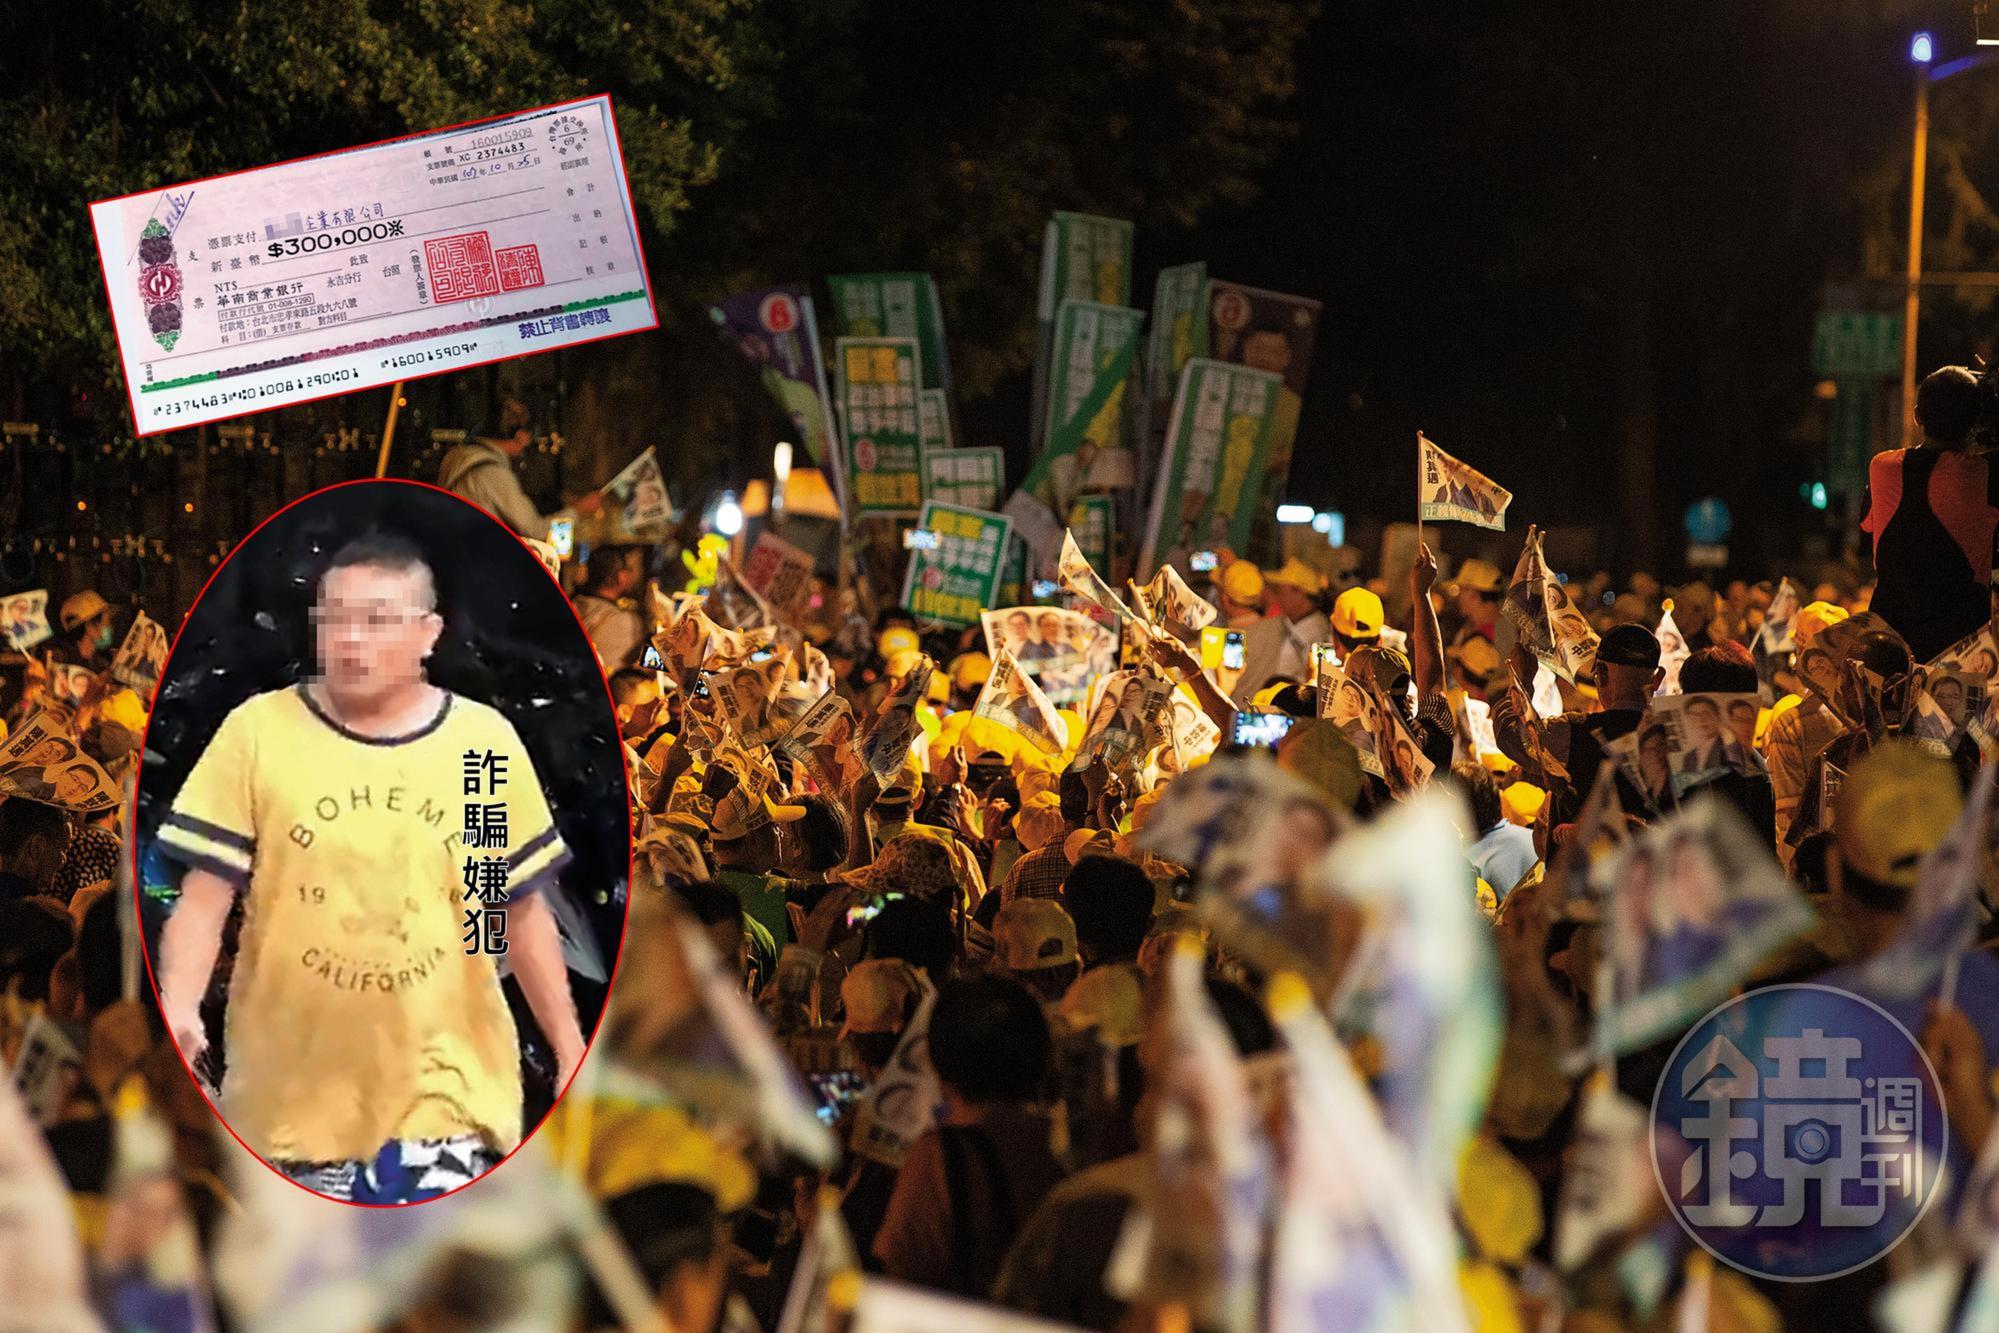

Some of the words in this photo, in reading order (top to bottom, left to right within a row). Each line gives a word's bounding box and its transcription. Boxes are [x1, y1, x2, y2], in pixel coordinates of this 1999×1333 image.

[459, 152, 471, 162] XC
[477, 143, 525, 160] 2374483
[217, 282, 304, 308] 華南商業銀行
[8, 724, 46, 758] 陳其邁
[289, 784, 463, 858] BOHEME
[301, 946, 446, 993] CALIFORNIA
